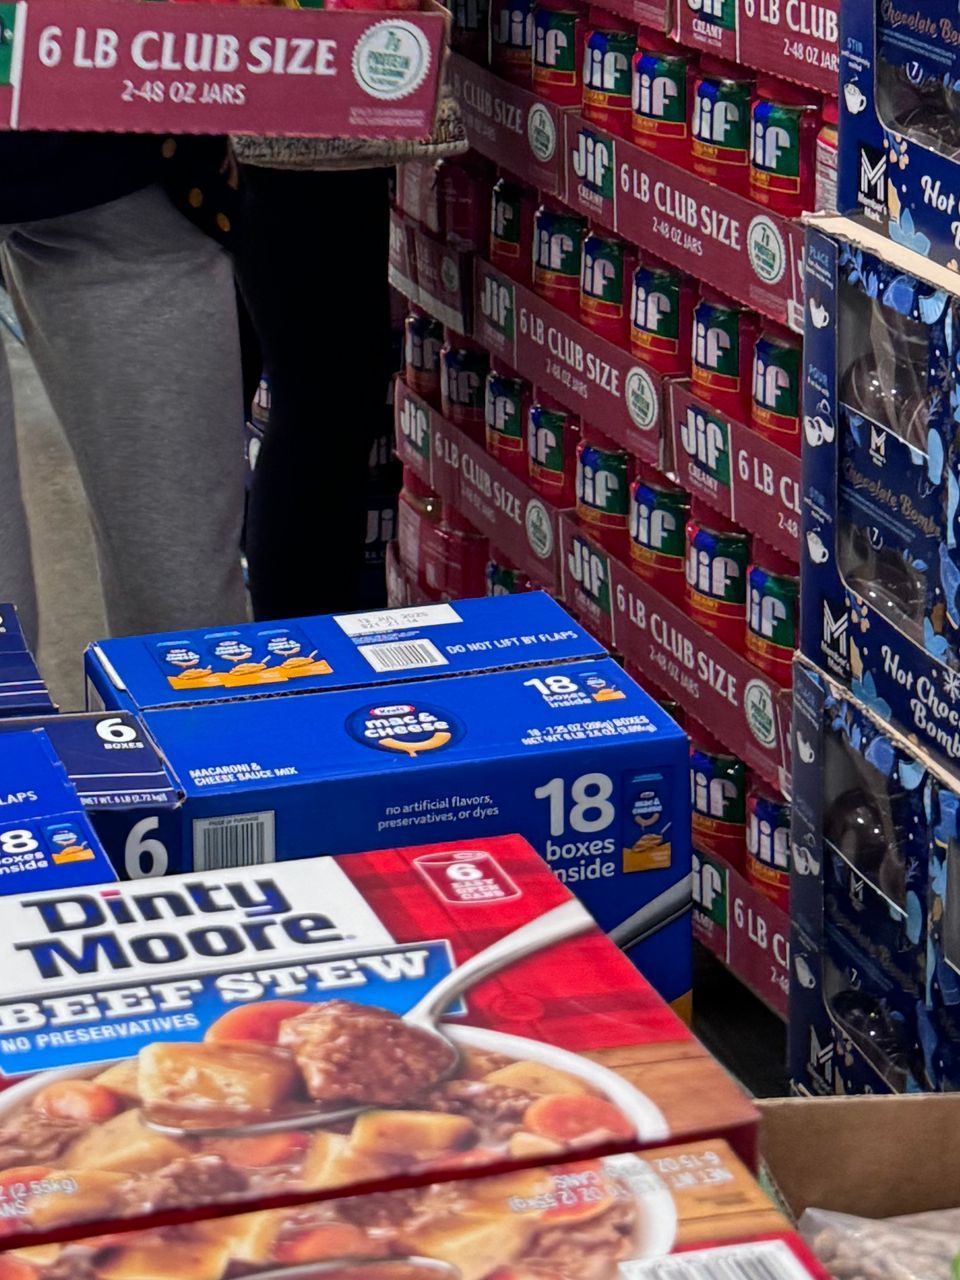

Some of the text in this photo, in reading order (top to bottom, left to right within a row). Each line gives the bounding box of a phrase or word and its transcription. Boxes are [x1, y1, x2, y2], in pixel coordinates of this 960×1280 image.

[38, 24, 338, 76] 6 LB CLUB SIZE
[783, 38, 804, 61] 2-48
[121, 80, 247, 106] 2-48 OZ JARS
[573, 133, 608, 187] Jif
[620, 163, 741, 251] 6 LB CLUB SIZE
[920, 174, 948, 214] Hot
[530, 313, 544, 345] LB
[547, 327, 584, 371] CLUB
[586, 352, 621, 398] SIZE
[680, 407, 724, 470] Jif
[738, 450, 773, 496] 6 LB
[493, 481, 522, 525] SIZE
[569, 539, 604, 598] Jif
[447, 630, 578, 655] DO NOT LIFT BY FLAPS
[617, 584, 738, 707] 6 LB CLUB SIZE
[880, 644, 914, 684] Hot
[524, 675, 579, 695] 18
[543, 690, 587, 703] boxes
[549, 697, 593, 709] inside
[95, 717, 137, 743] 6
[365, 711, 438, 728] mac &
[379, 705, 406, 716] Kraft
[103, 741, 145, 750] BOXES
[188, 762, 261, 780] MACARONI &
[194, 765, 298, 786] CHEESE SAUCE MIX
[377, 805, 499, 832] preservatives, or dyes
[386, 793, 494, 816] no artificial flavors,
[534, 773, 615, 833] 18
[124, 815, 168, 880] 6
[546, 837, 616, 859] boxes
[446, 863, 482, 881] 6
[21, 875, 293, 933] Dinty
[733, 897, 768, 949] 6 LB
[14, 909, 340, 980] Moore
[214, 949, 431, 1002] STEW
[0, 1012, 200, 1055] NO PRESERVATIVES
